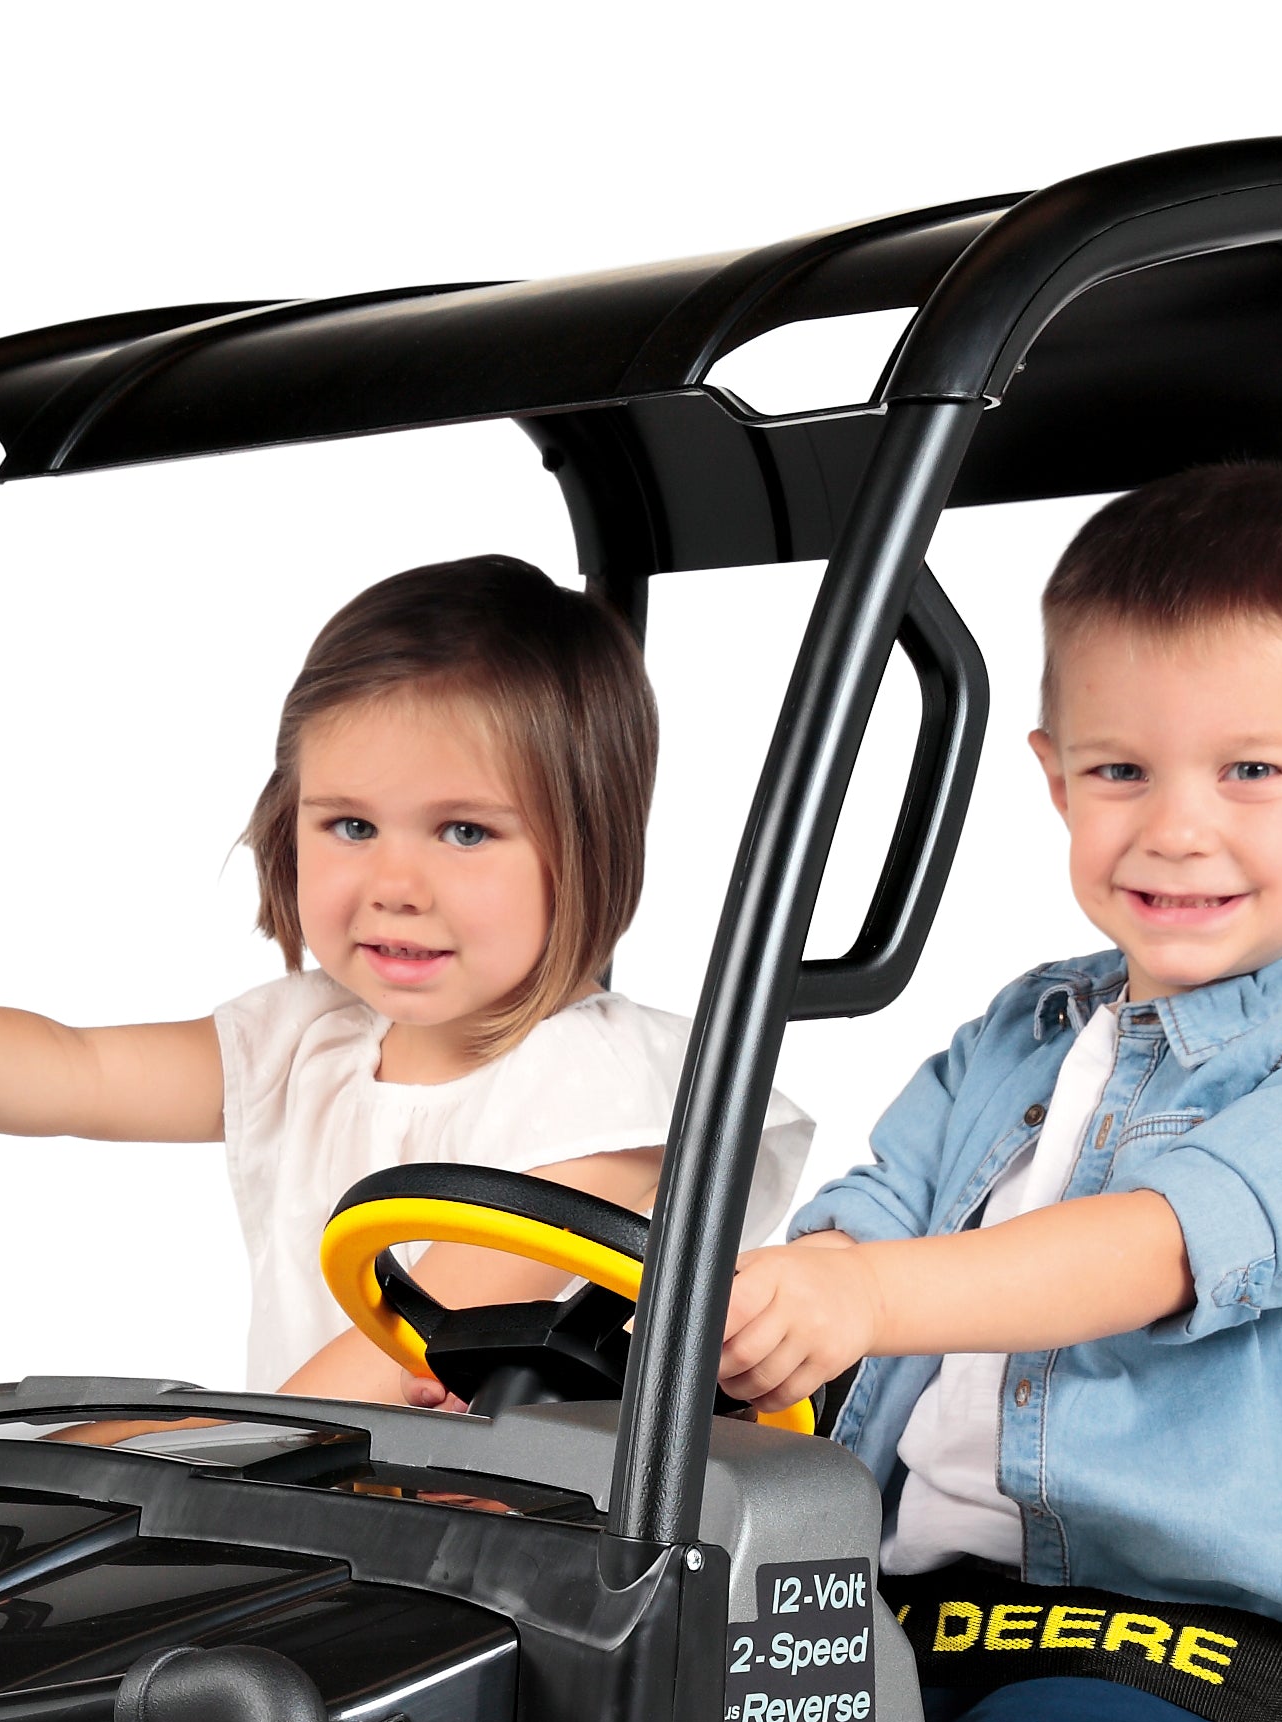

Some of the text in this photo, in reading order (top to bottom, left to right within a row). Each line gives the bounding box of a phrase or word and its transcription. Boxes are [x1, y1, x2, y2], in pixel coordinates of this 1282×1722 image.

[771, 1572, 867, 1614] 12-Volt
[729, 1627, 869, 1676] 2-Speed
[932, 1600, 1239, 1685] DEERE
